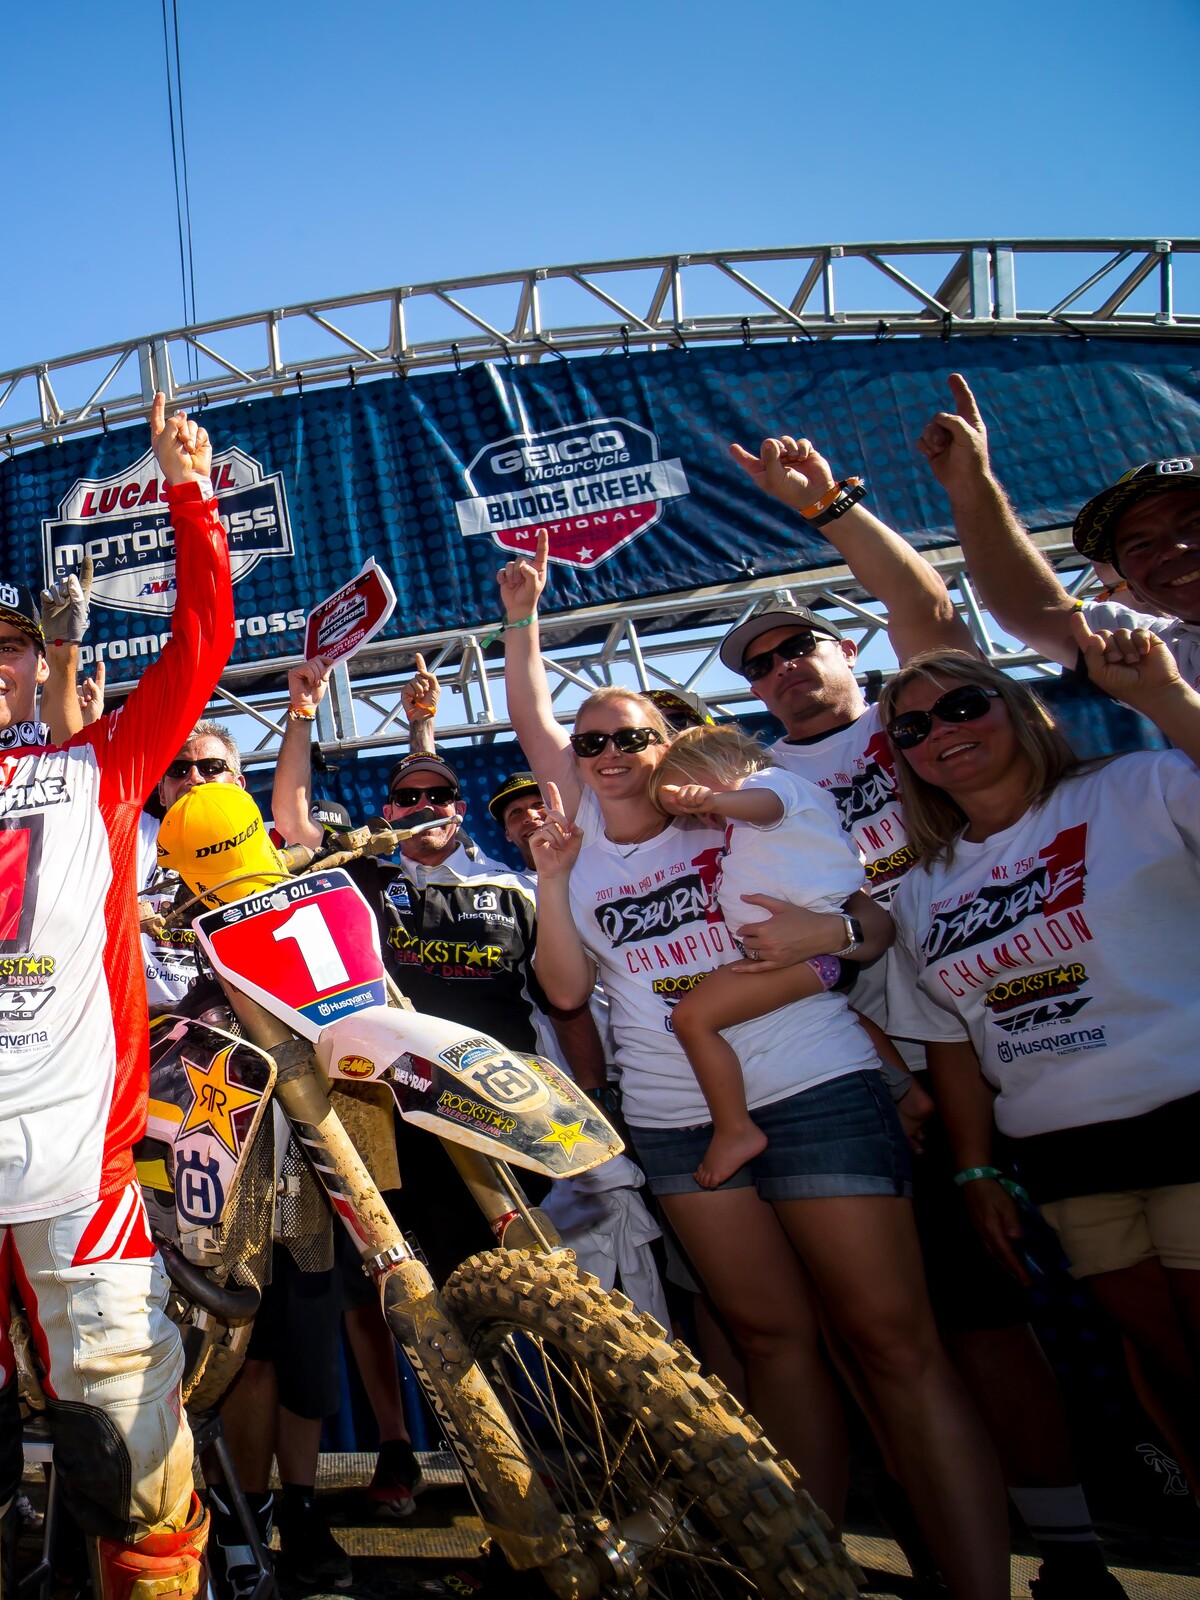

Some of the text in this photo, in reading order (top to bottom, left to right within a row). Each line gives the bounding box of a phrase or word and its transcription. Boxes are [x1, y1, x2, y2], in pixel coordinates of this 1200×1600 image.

[490, 430, 626, 475] GEICO
[525, 450, 630, 482] Motorcycle
[487, 471, 658, 524] BUDDS CREEK
[195, 817, 260, 859] DUNLOP
[290, 882, 313, 899] OIL
[595, 861, 687, 902] 2017 AMA PRO MX 250
[930, 898, 953, 915] 2017
[991, 865, 1009, 881] MX
[1014, 856, 1036, 875] 250
[458, 912, 516, 925] Husqvarna
[924, 860, 1085, 958] OSBORNE
[272, 902, 351, 993] 1
[938, 909, 1094, 998] CHAMPION
[7, 974, 47, 986] DRINK
[329, 991, 373, 1012] Husqvarna
[1011, 1018, 1072, 1037] RACING
[1012, 1027, 1105, 1058] Husqvarna
[339, 1059, 375, 1076] FMF
[438, 1091, 519, 1134] ROCKSTAR
[438, 1104, 501, 1138] ENERGY DRINK
[401, 1343, 488, 1494] DUNLOP
